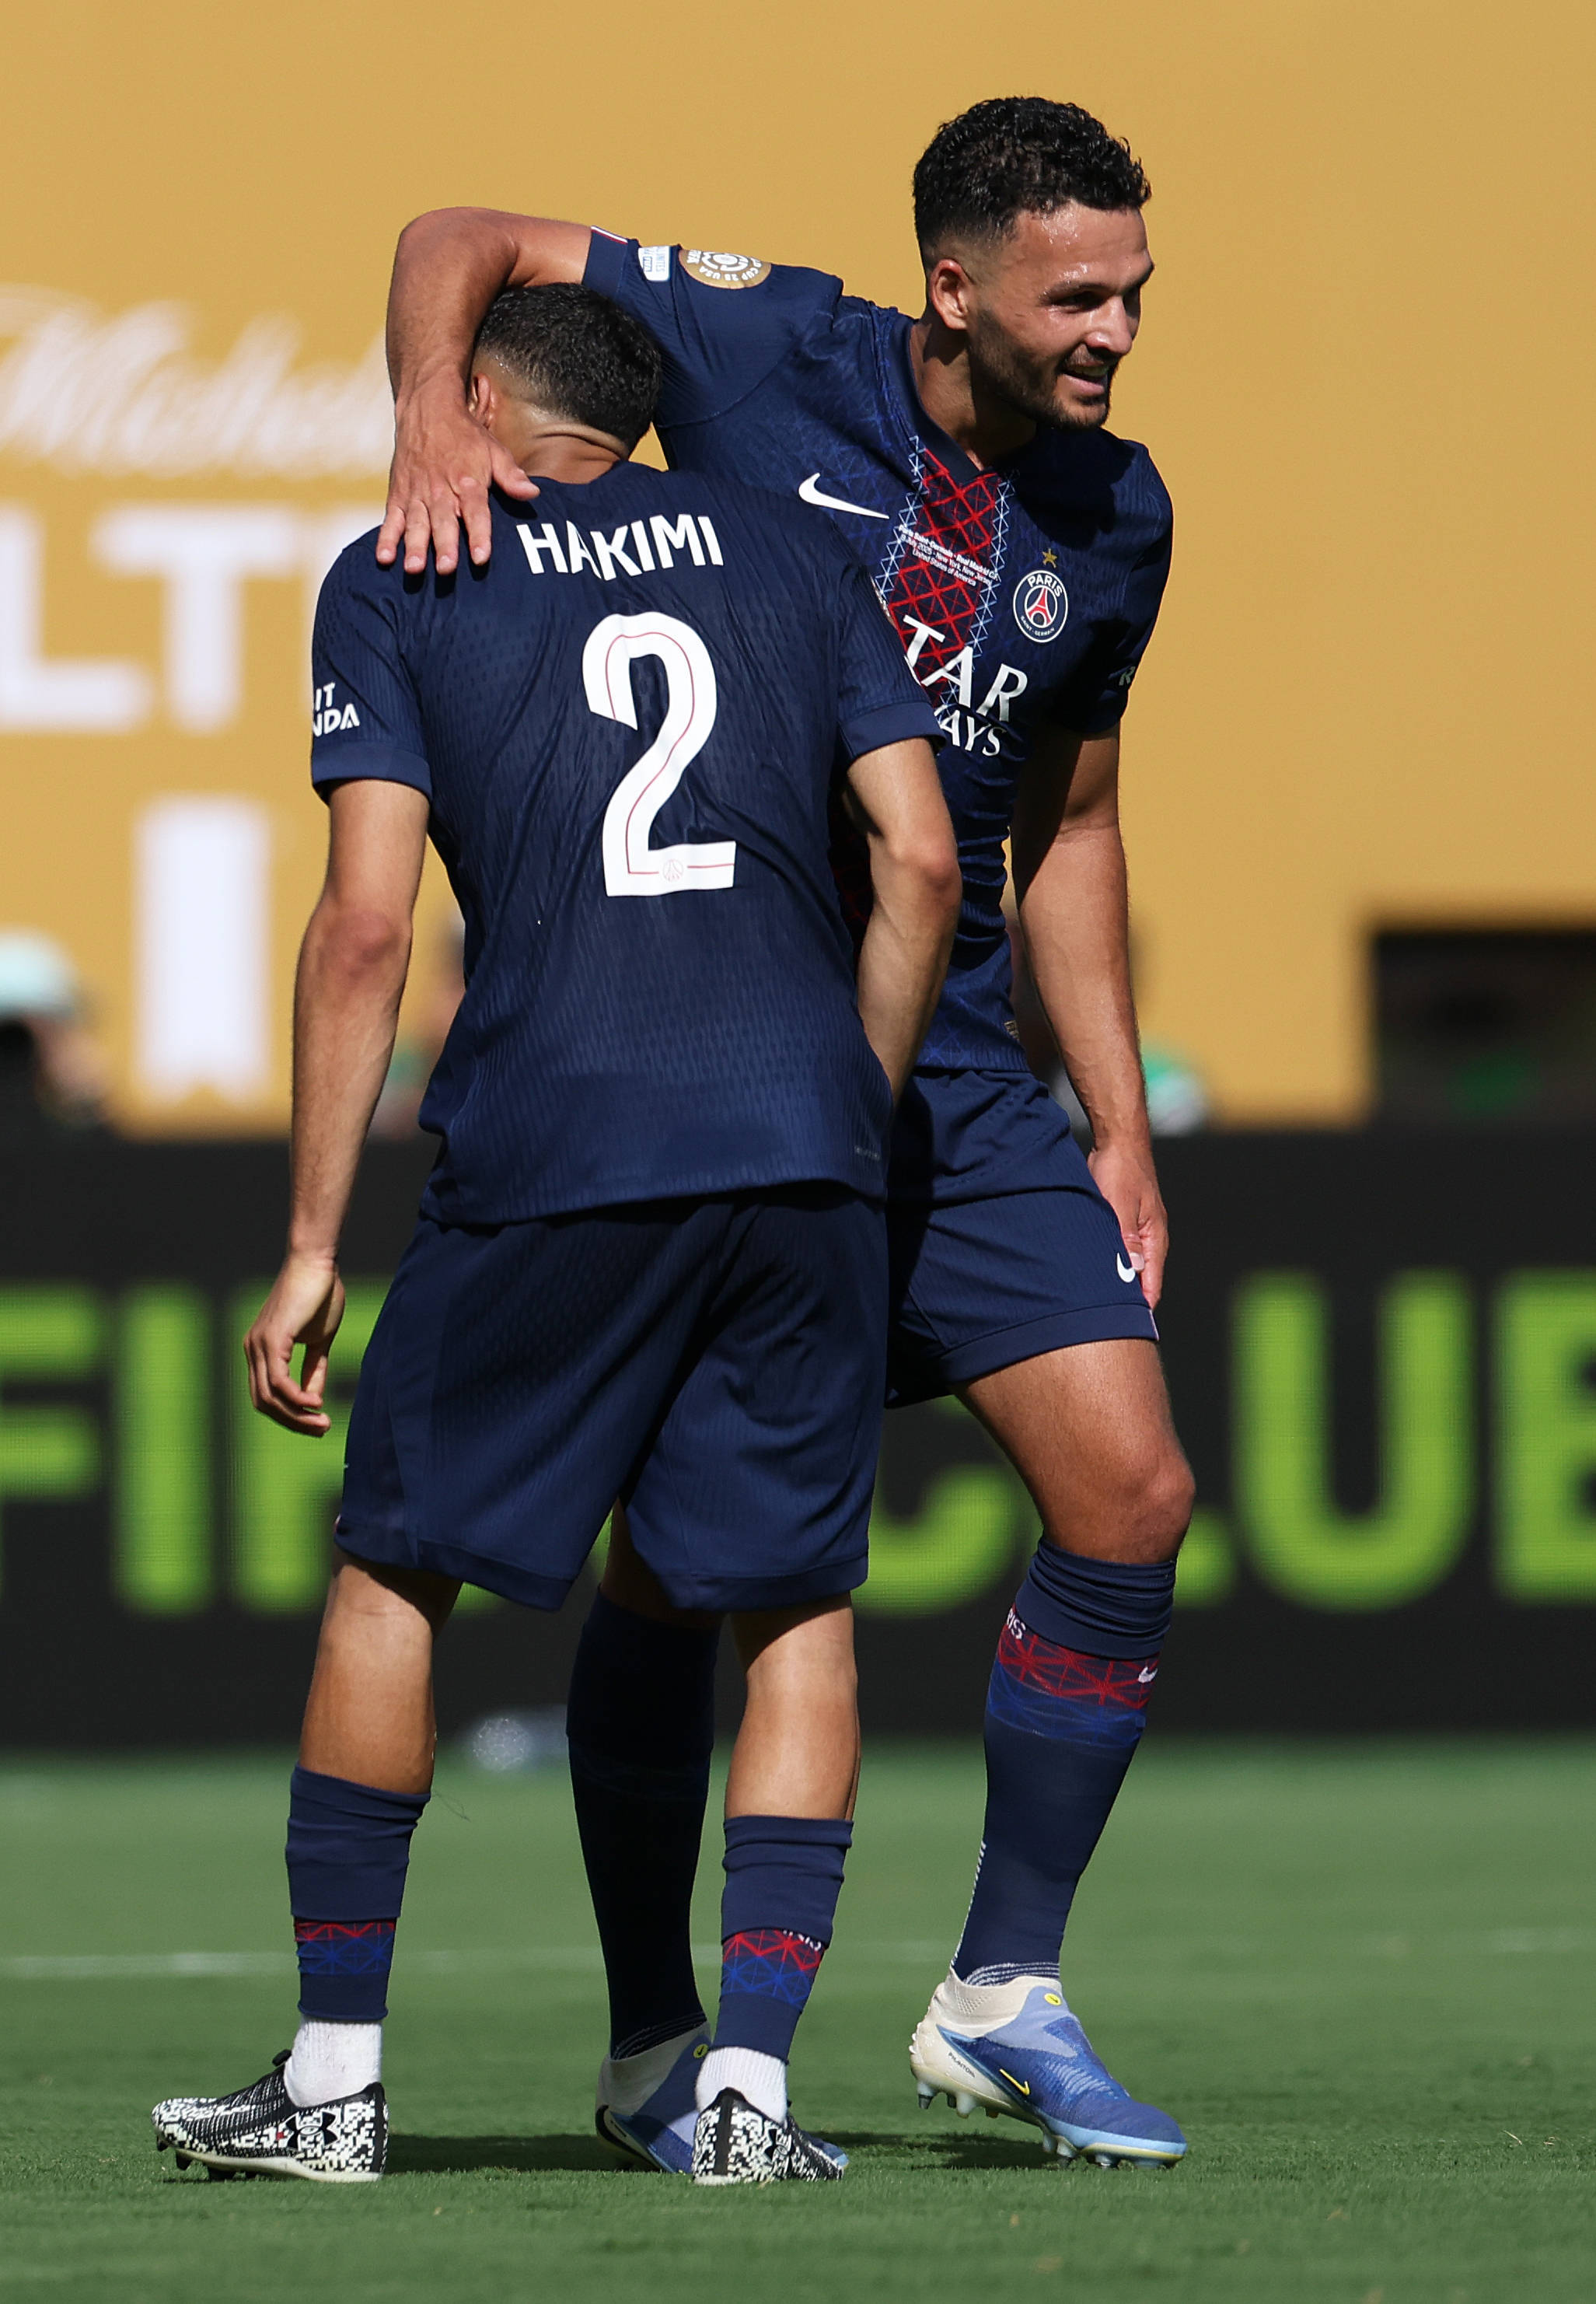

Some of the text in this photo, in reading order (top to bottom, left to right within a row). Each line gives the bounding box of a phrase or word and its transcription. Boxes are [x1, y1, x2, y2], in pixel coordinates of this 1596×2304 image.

[515, 514, 724, 581] HAKIMI
[1027, 574, 1063, 597] PARIS
[903, 614, 1028, 722] TAR
[581, 611, 736, 897] 2
[934, 704, 1008, 756] AYS
